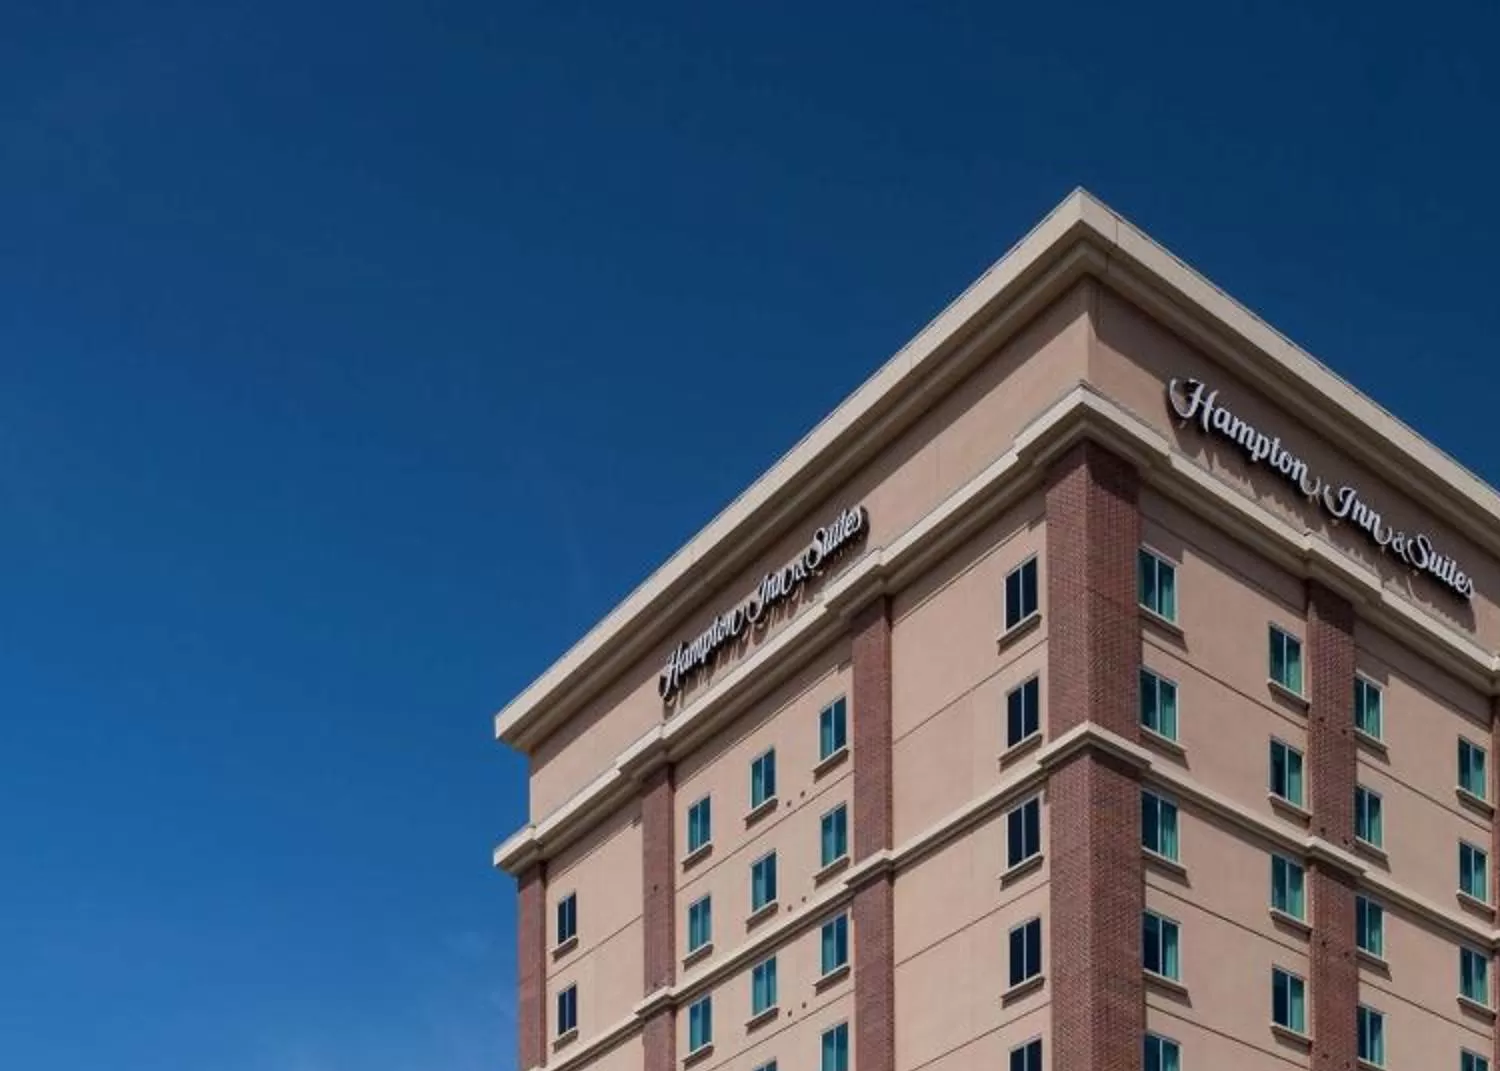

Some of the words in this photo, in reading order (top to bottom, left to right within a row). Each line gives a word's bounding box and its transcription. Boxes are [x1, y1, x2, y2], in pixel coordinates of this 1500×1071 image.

[1169, 376, 1321, 497] Hampton
[1324, 485, 1393, 544] Inn
[1392, 531, 1410, 564] &
[1407, 533, 1476, 599] Suites
[660, 606, 748, 698] Hampton
[746, 568, 794, 624] Inn
[805, 505, 862, 569] Suites
